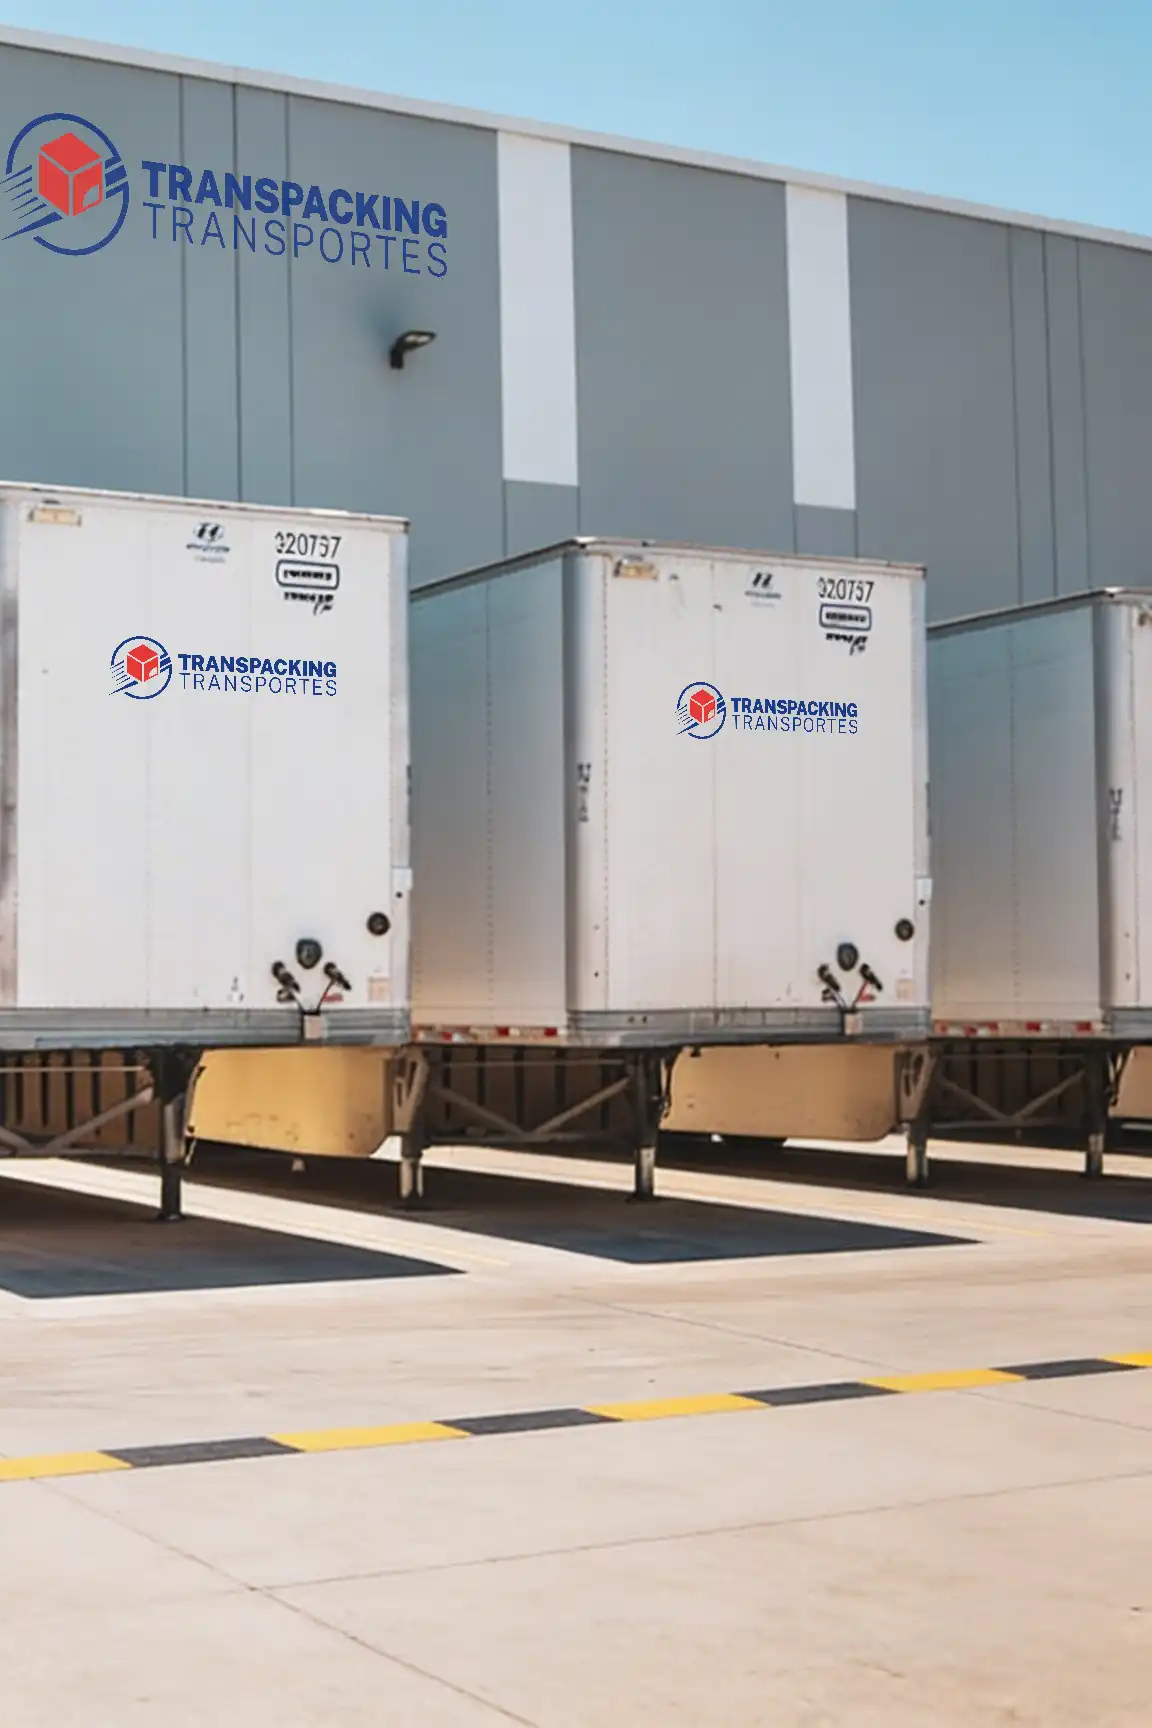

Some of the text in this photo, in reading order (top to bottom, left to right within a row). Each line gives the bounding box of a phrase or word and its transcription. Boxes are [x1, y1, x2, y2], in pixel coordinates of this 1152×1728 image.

[141, 158, 448, 239] TRANSPACKING
[142, 202, 448, 278] TRANSPORTES
[177, 653, 337, 678] TRANSPACKING
[178, 672, 337, 696] TRANSPORTES
[730, 697, 859, 718] TRANSPACKING
[731, 714, 859, 735] TRANSPORTES
